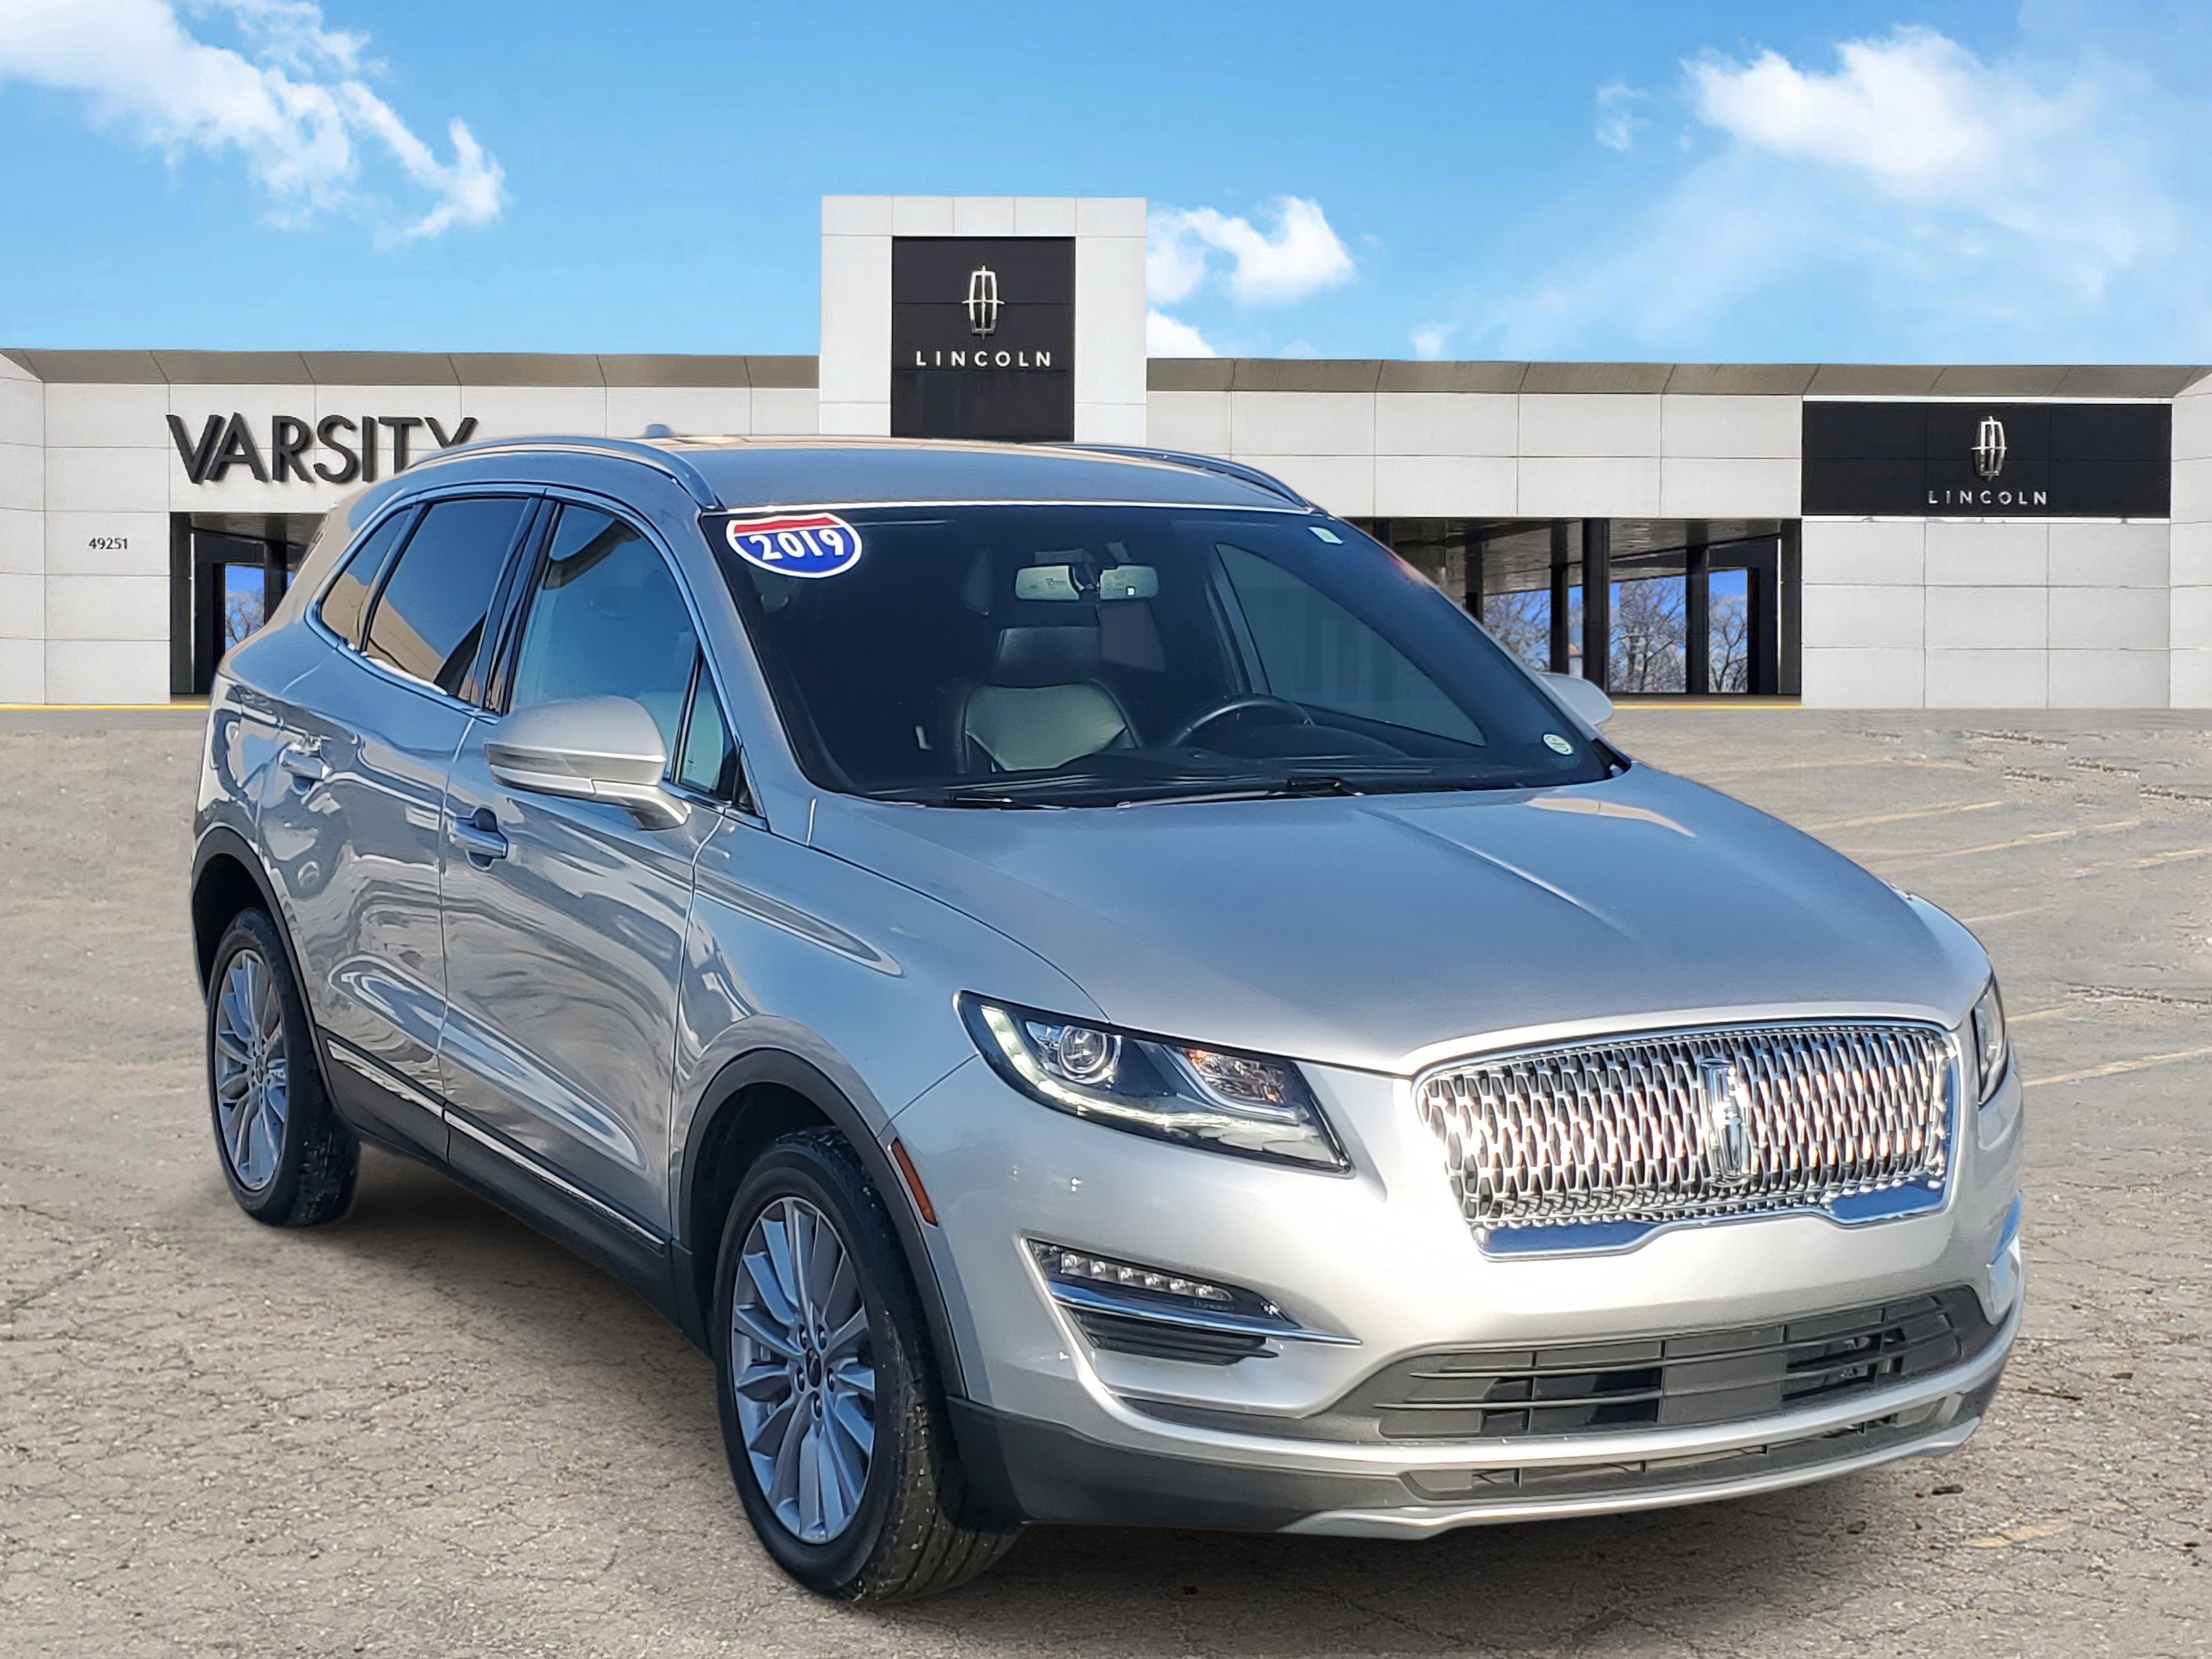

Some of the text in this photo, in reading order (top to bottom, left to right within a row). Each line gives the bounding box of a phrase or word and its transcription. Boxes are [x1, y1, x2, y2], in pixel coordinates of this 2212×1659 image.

[916, 351, 1051, 367] LINCOLN
[166, 412, 478, 484] VARSITY
[1929, 491, 2047, 505] LINCOLN
[89, 538, 127, 549] 49251
[749, 528, 844, 561] 2019
